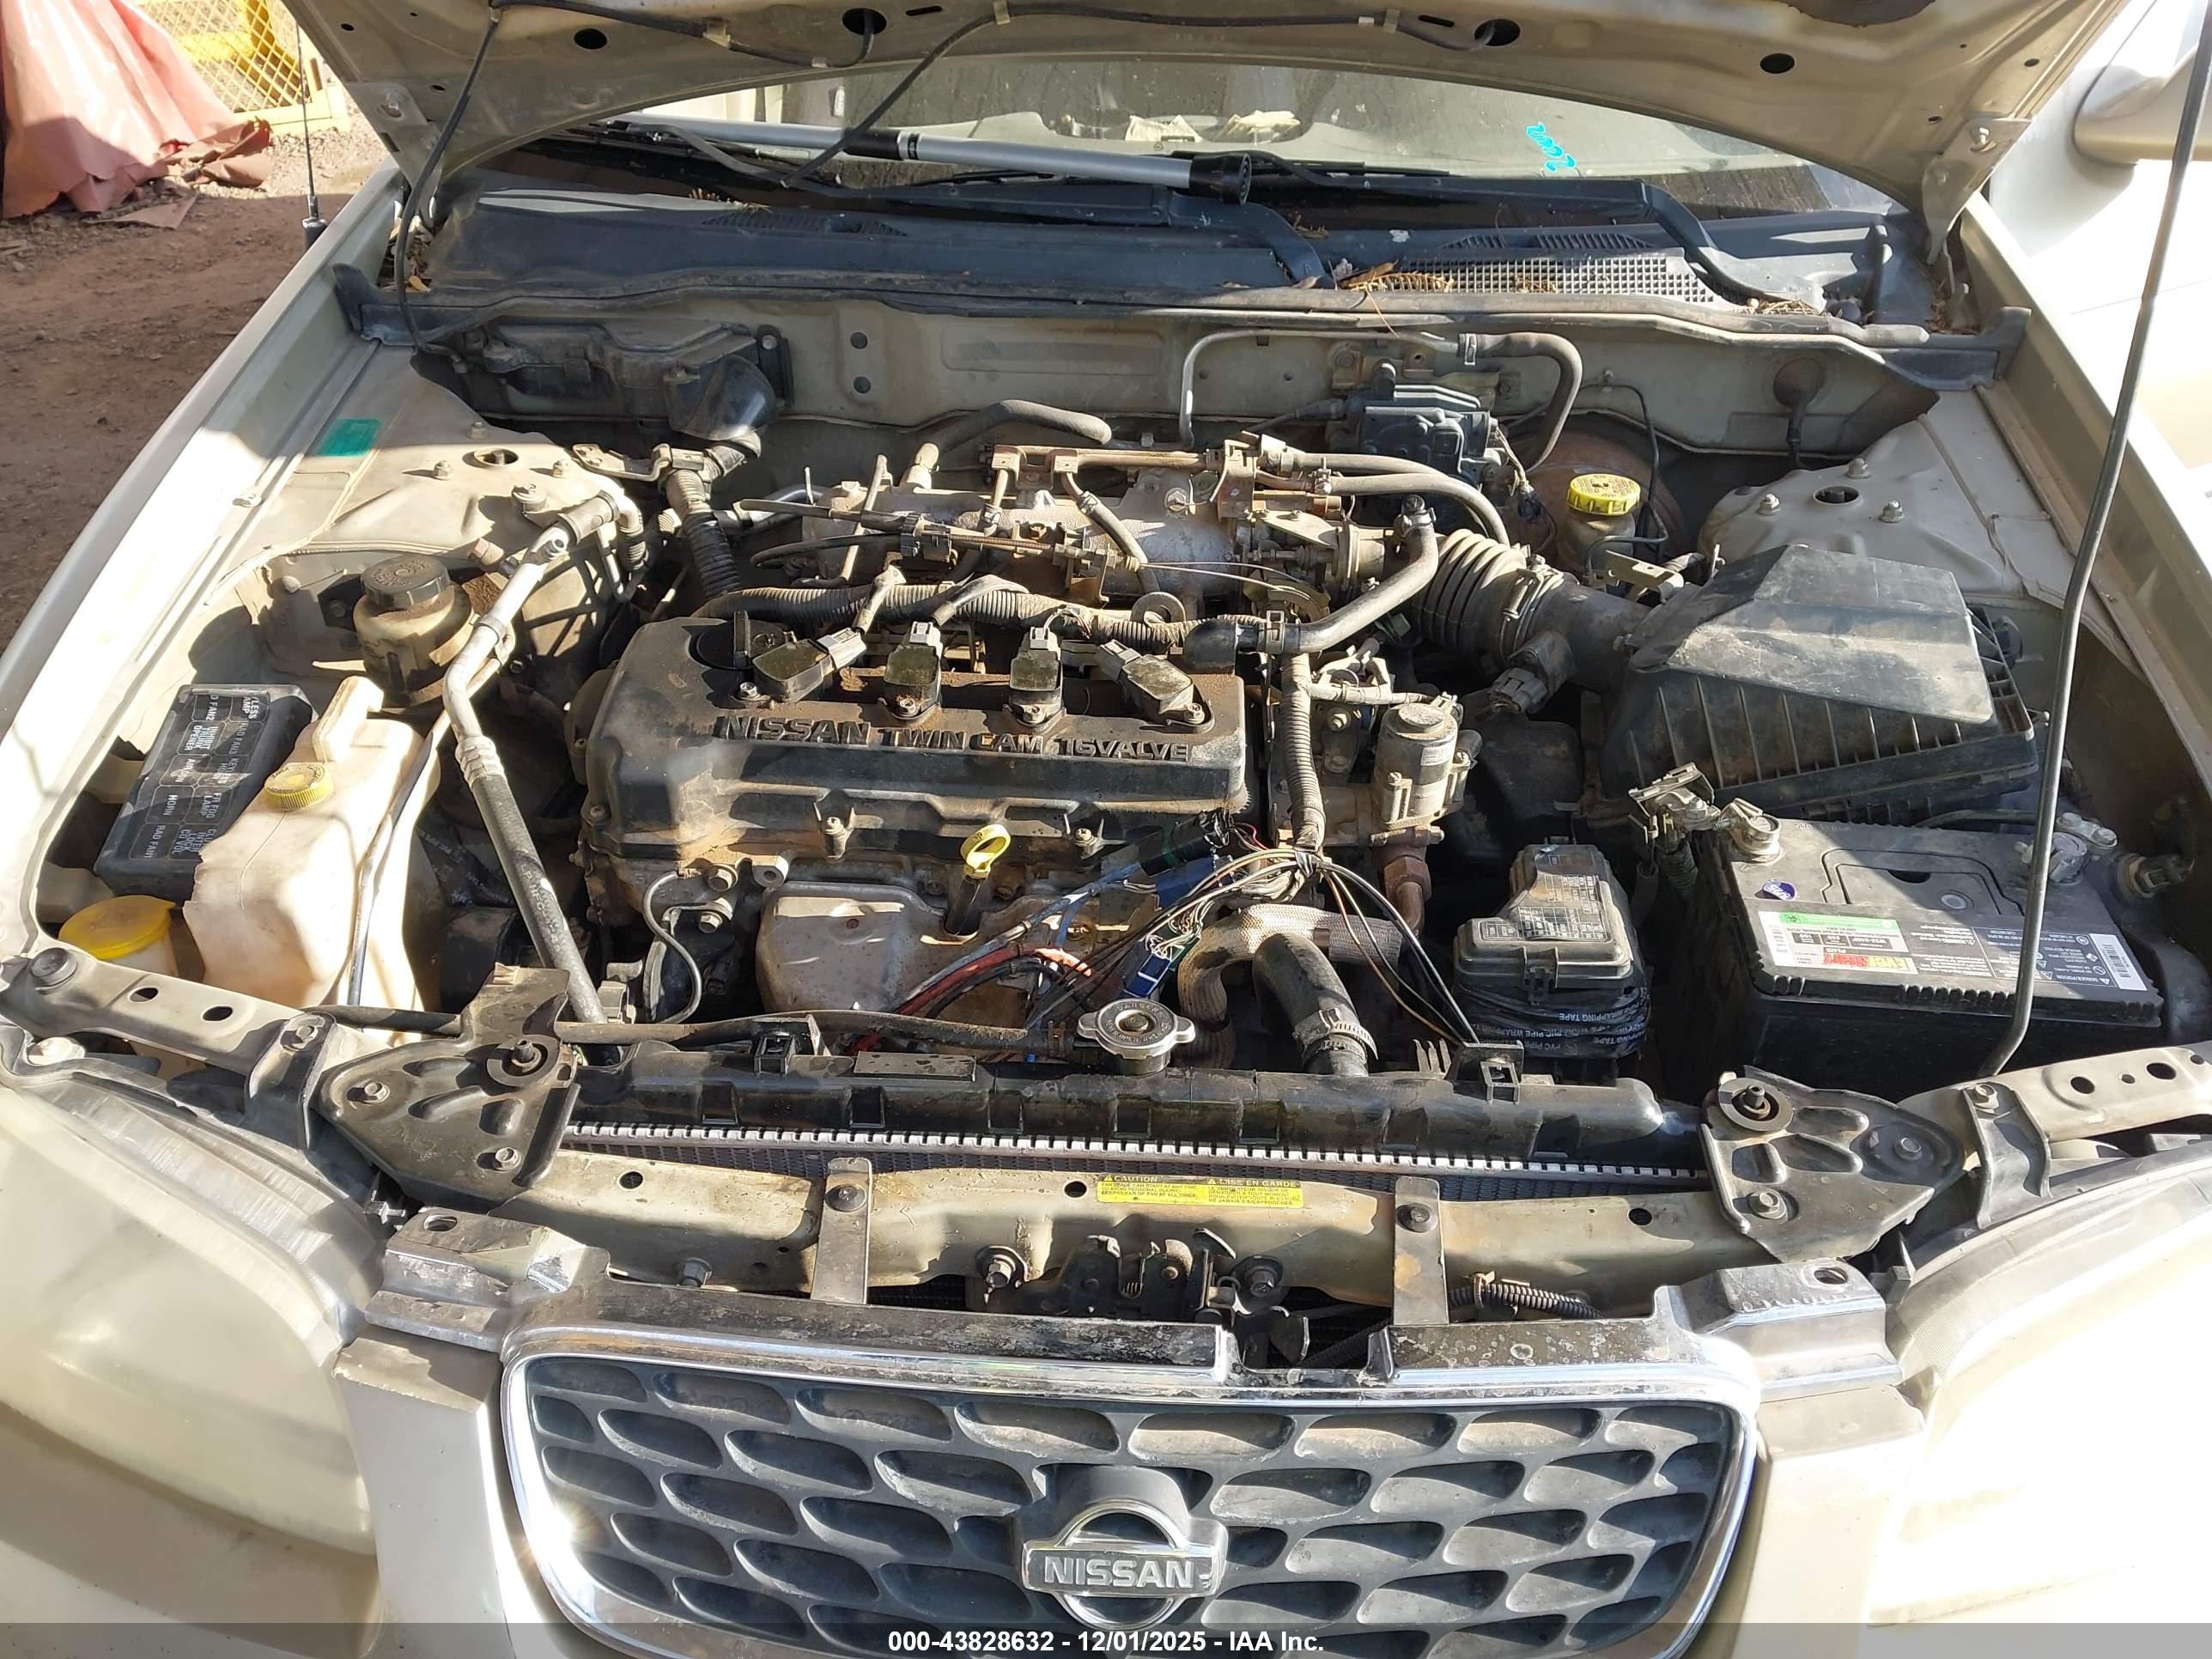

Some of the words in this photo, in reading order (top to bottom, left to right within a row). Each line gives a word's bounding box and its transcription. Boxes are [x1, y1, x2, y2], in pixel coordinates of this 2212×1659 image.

[184, 725, 198, 750] OPENER
[711, 715, 870, 745] NISSAN
[881, 728, 968, 750] TWIN
[969, 732, 1043, 755] CAM
[1055, 737, 1189, 763] 16VALVE
[163, 794, 179, 817] HORN
[198, 795, 212, 817] LAMP
[150, 824, 166, 840] RAD
[143, 840, 160, 859] FAN1
[1559, 1012, 1582, 1022] TAPE
[1525, 1030, 1545, 1038] PIPE
[1044, 1555, 1195, 1589] NISSAN
